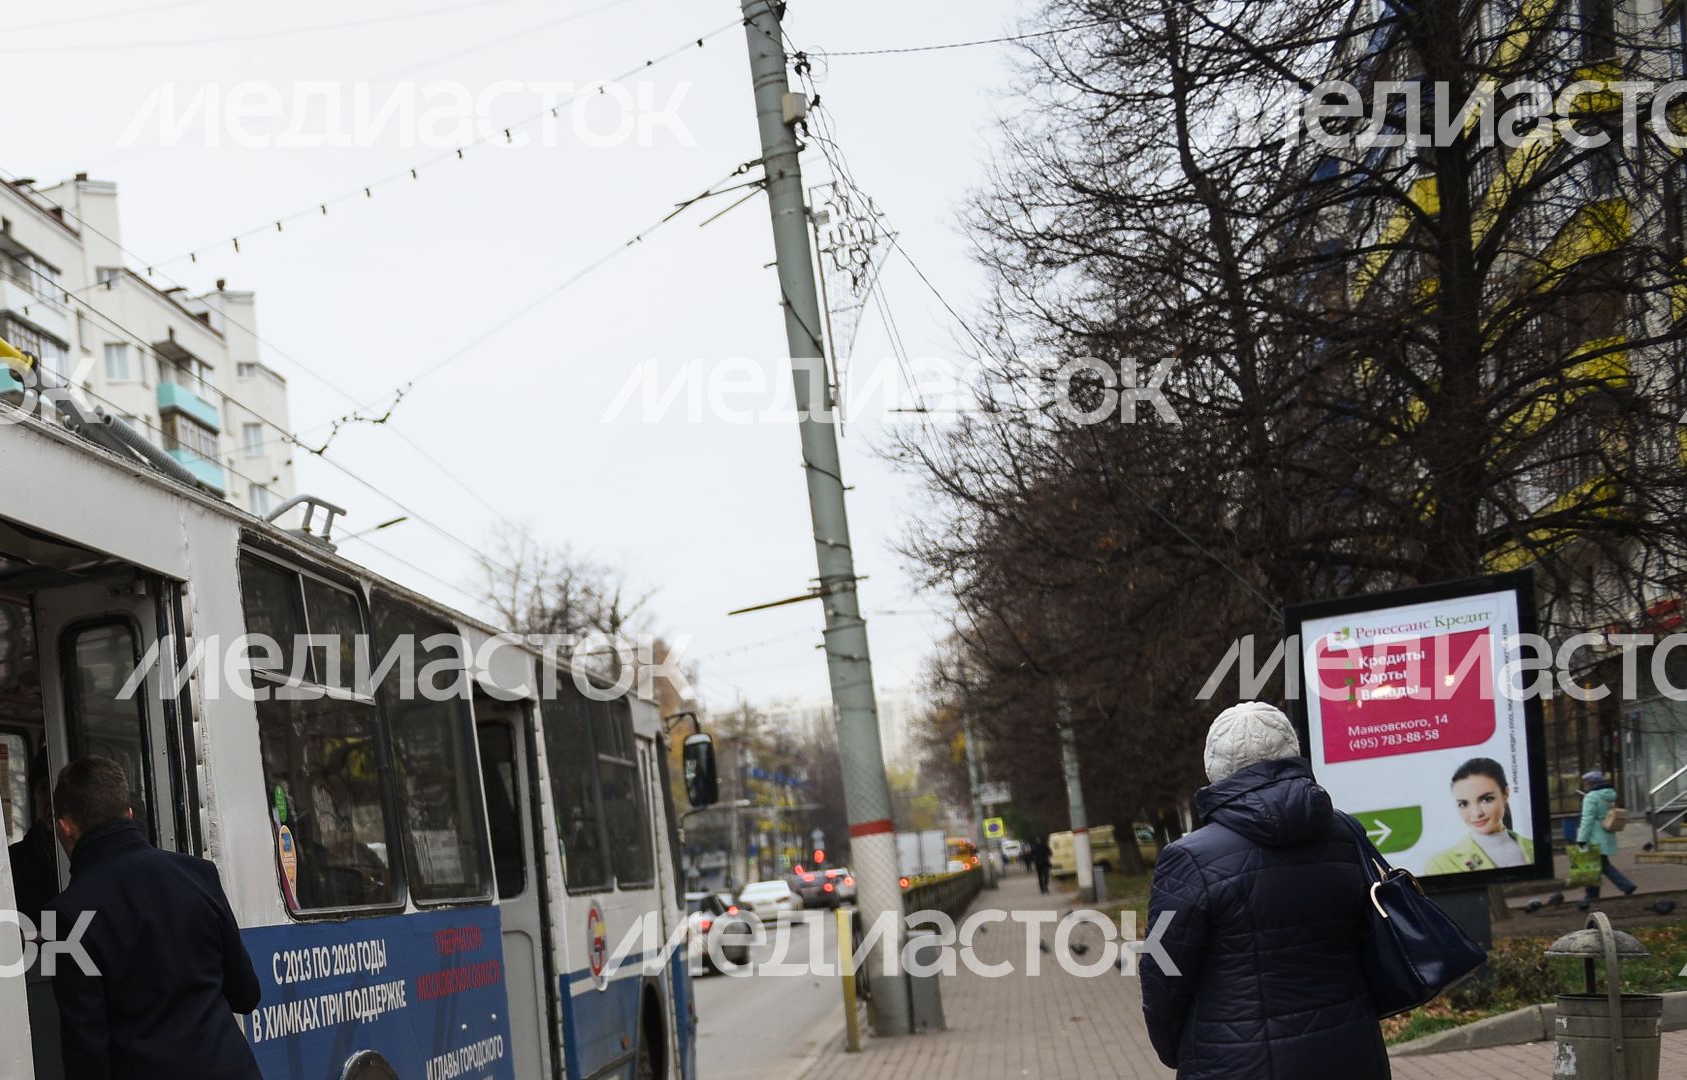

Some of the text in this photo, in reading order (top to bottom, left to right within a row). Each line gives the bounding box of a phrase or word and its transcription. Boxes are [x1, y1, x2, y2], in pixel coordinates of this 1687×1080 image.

[1355, 610, 1492, 639] Ренессанс Кредит
[1358, 650, 1426, 669] Кредиты
[1360, 669, 1407, 687] Карты
[1348, 714, 1449, 737] Маяковского, 14
[1349, 730, 1440, 751] (495) 783-88-58
[273, 939, 387, 985] С 2013 ПО 2018 ГОДЫ
[252, 980, 406, 1043] В ХИМКАХ ПРИ ПОДДЕРЖКЕ
[459, 1034, 504, 1074] ГОРОДСКОГО
